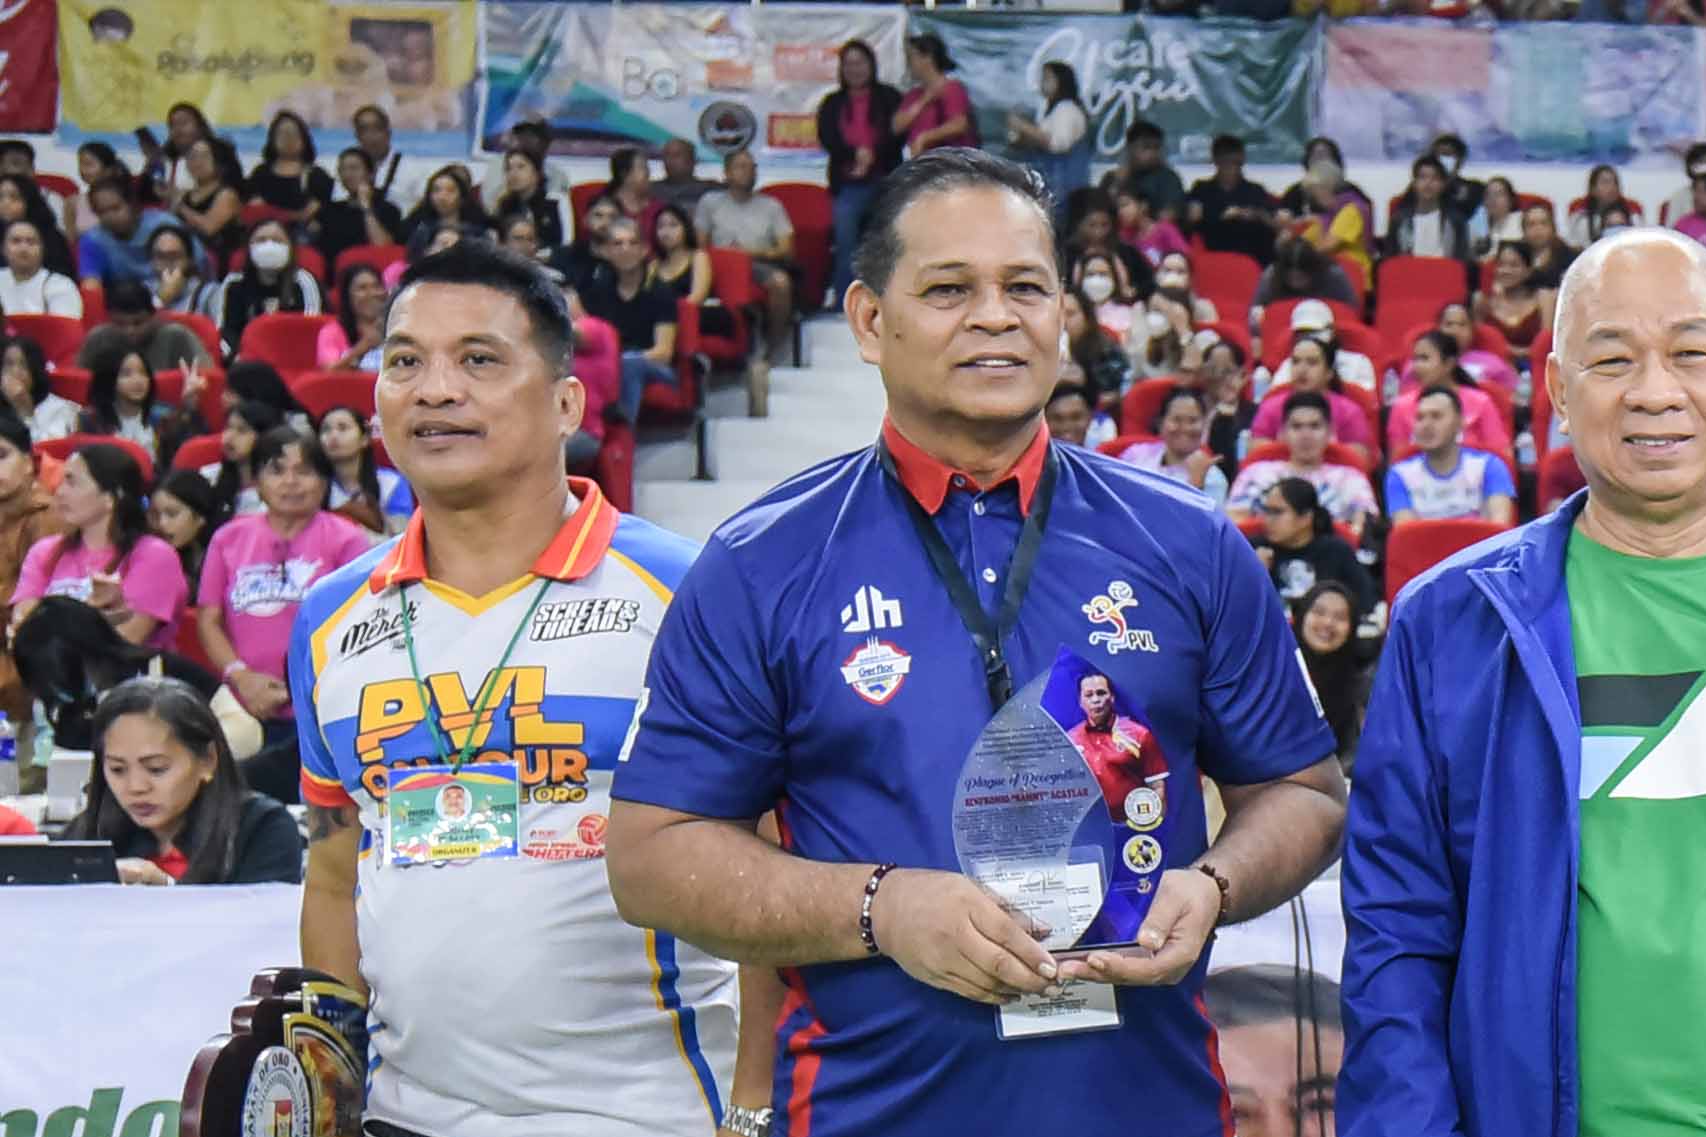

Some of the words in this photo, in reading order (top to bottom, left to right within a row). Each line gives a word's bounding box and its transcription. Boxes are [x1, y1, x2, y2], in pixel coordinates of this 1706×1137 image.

[534, 598, 640, 622] SCREENS
[1127, 610, 1159, 632] PVL
[530, 615, 631, 641] THREADS
[355, 665, 585, 762] PVL
[533, 784, 589, 804] ORO
[271, 1051, 290, 1068] ORO
